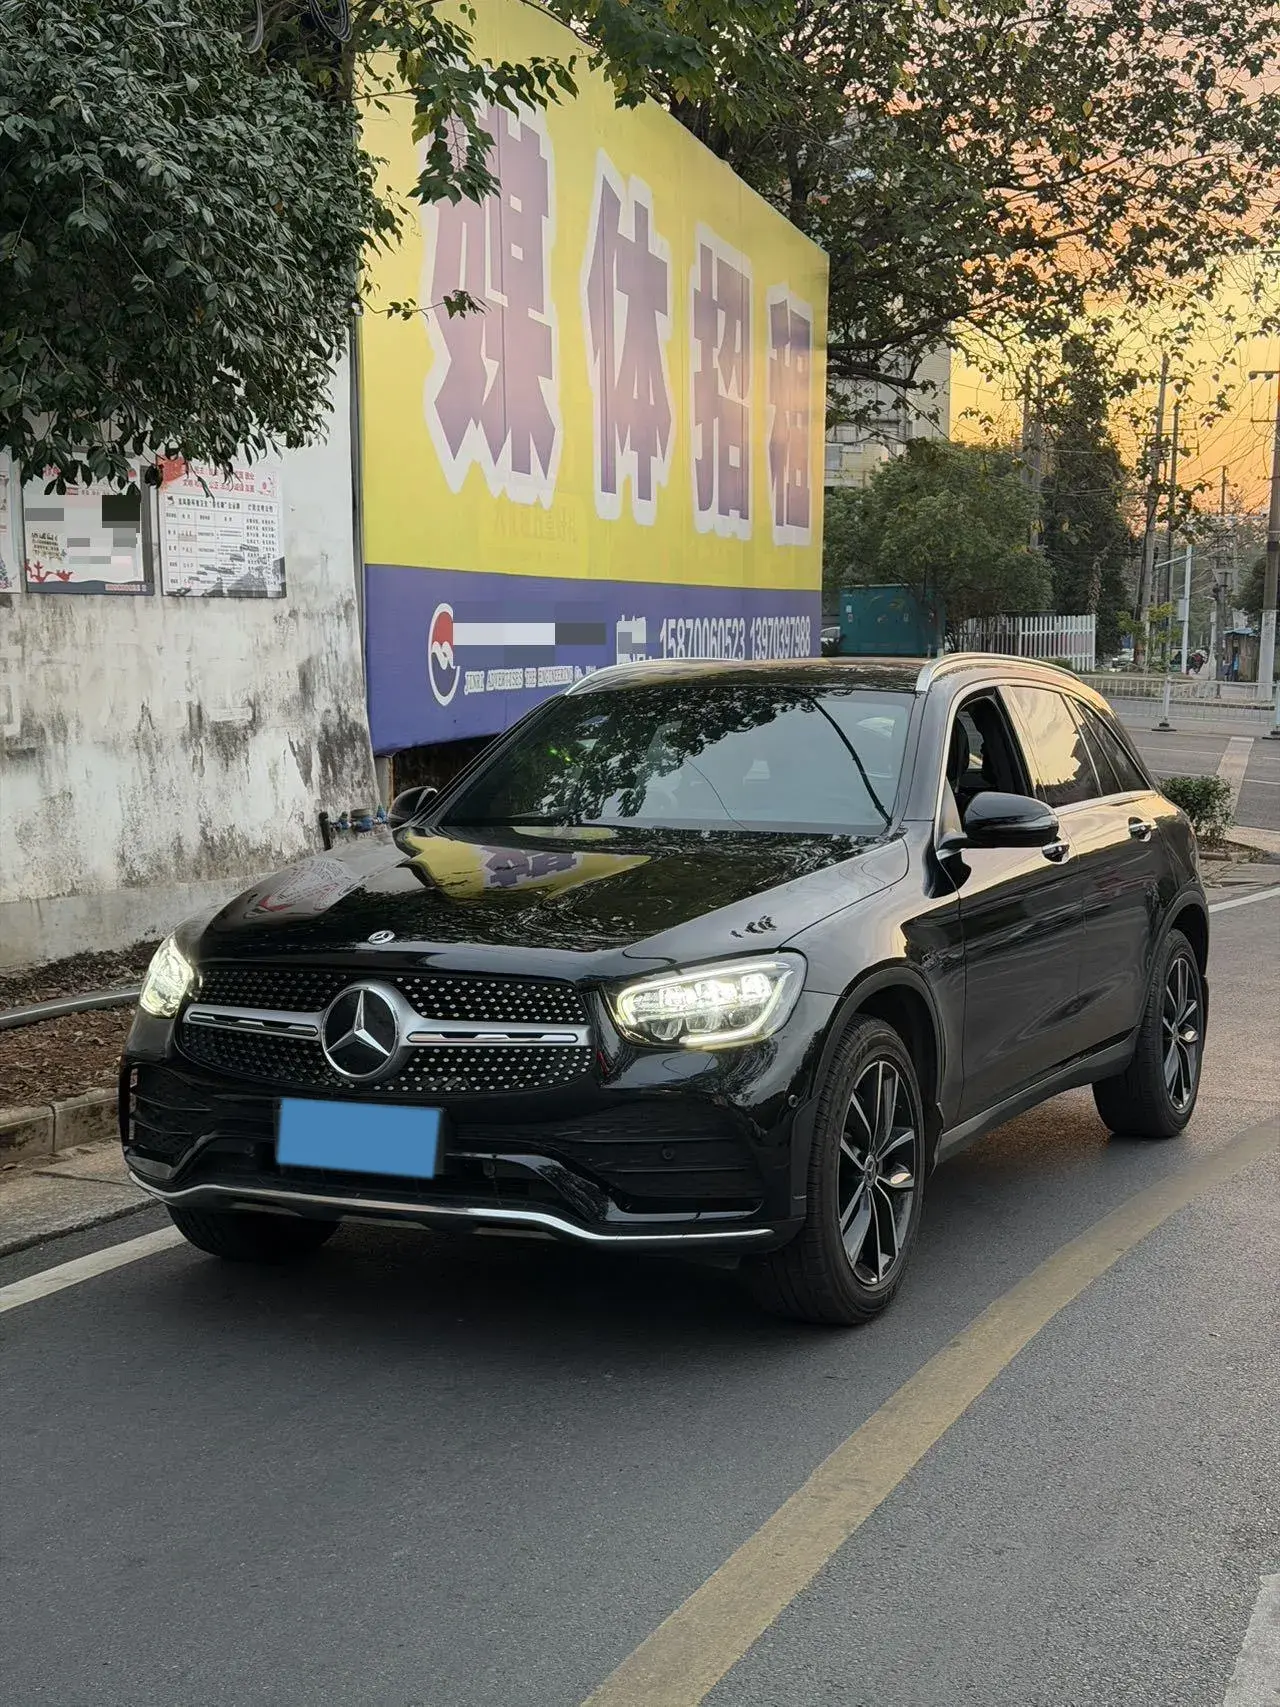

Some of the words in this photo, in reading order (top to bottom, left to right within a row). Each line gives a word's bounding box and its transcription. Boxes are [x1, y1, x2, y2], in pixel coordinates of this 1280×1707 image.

[428, 96, 814, 532] 媒体招租
[660, 617, 746, 660] 15870060523
